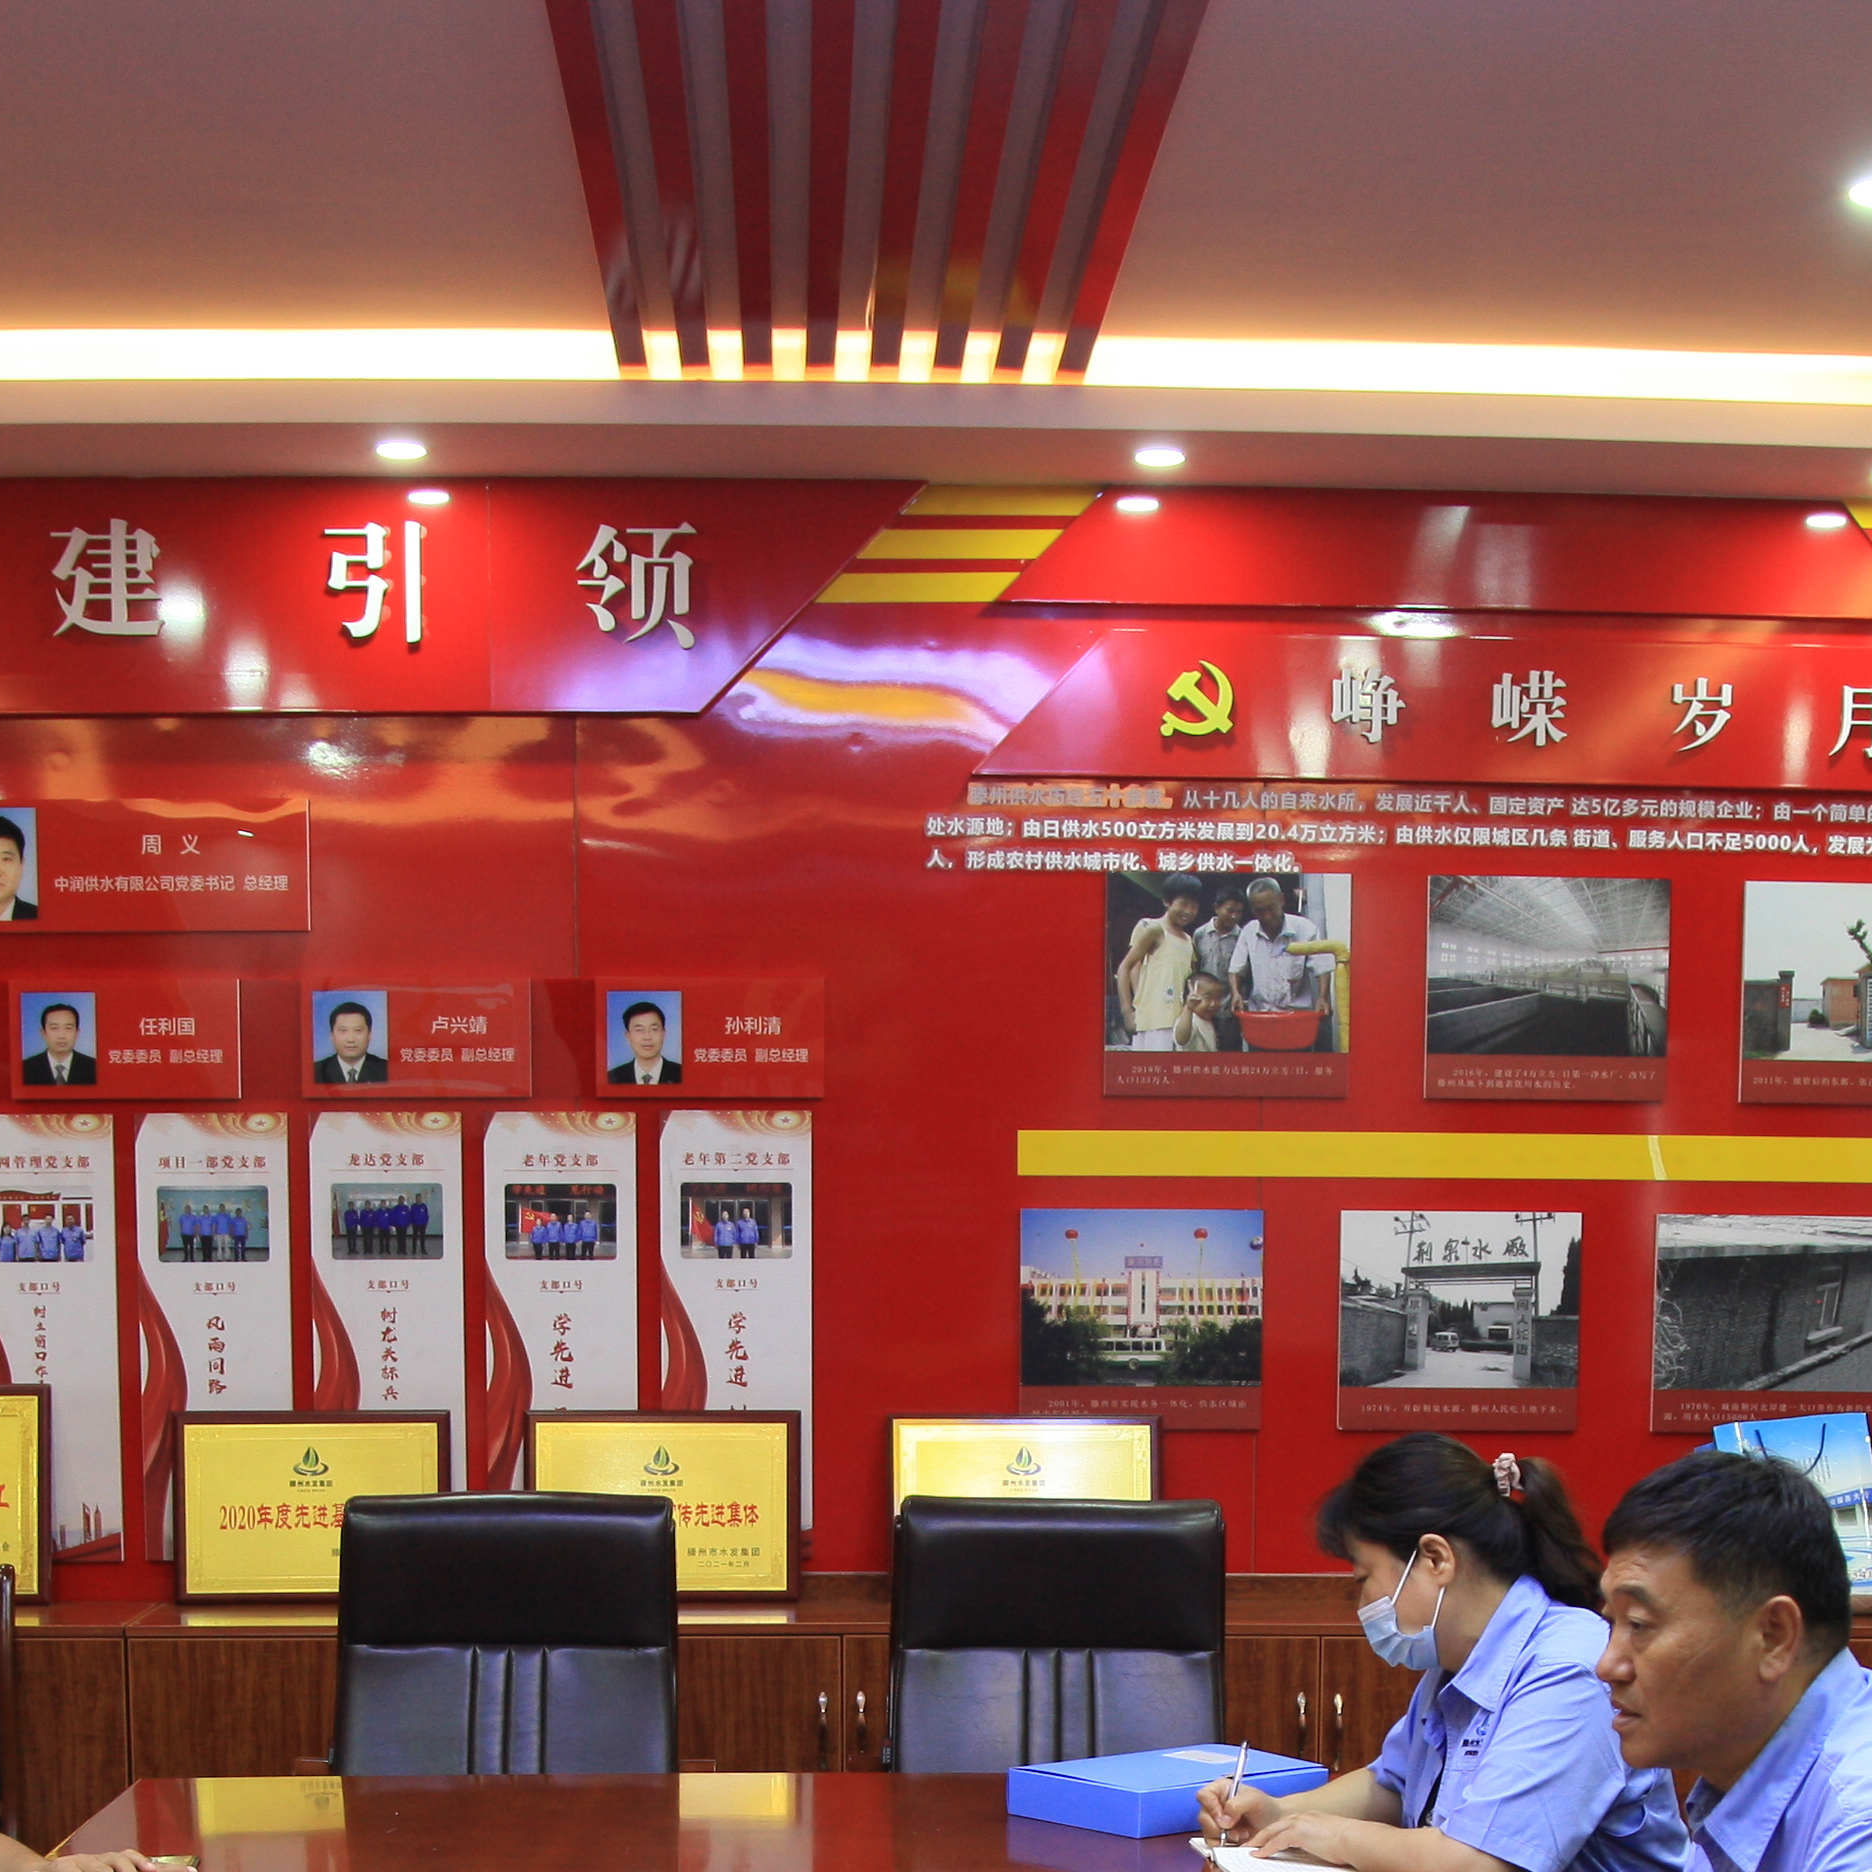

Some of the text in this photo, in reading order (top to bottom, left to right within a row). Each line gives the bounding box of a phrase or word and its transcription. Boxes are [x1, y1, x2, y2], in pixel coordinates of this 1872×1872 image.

[54, 874, 289, 893] 中润供水有限公司党委书记 总经理
[139, 1016, 195, 1037] 任利国
[431, 1016, 488, 1037] 卢兴靖
[724, 1016, 782, 1036] 孙利清
[108, 1047, 224, 1065] 党委委员 副总经理
[399, 1046, 515, 1064] 党委委员 副总经理
[693, 1047, 809, 1064] 党委委员 副总经理
[158, 1154, 267, 1170] 项目一部党支部
[348, 1152, 426, 1169] 龙达党支部
[522, 1152, 600, 1169] 老年党支部
[681, 1151, 792, 1167] 老年第二党支部
[18, 1281, 61, 1294] 支部口号
[193, 1280, 237, 1293] 支部口号
[366, 1279, 410, 1291] 支部口号
[539, 1278, 584, 1291] 支部口号
[714, 1278, 759, 1290] 支部口号
[33, 1305, 48, 1385] 树立窗口作
[549, 1313, 575, 1390] 学先进
[725, 1312, 750, 1389] 学先进
[206, 1316, 227, 1396] 风雨同路
[673, 1501, 759, 1527] 传先进集体
